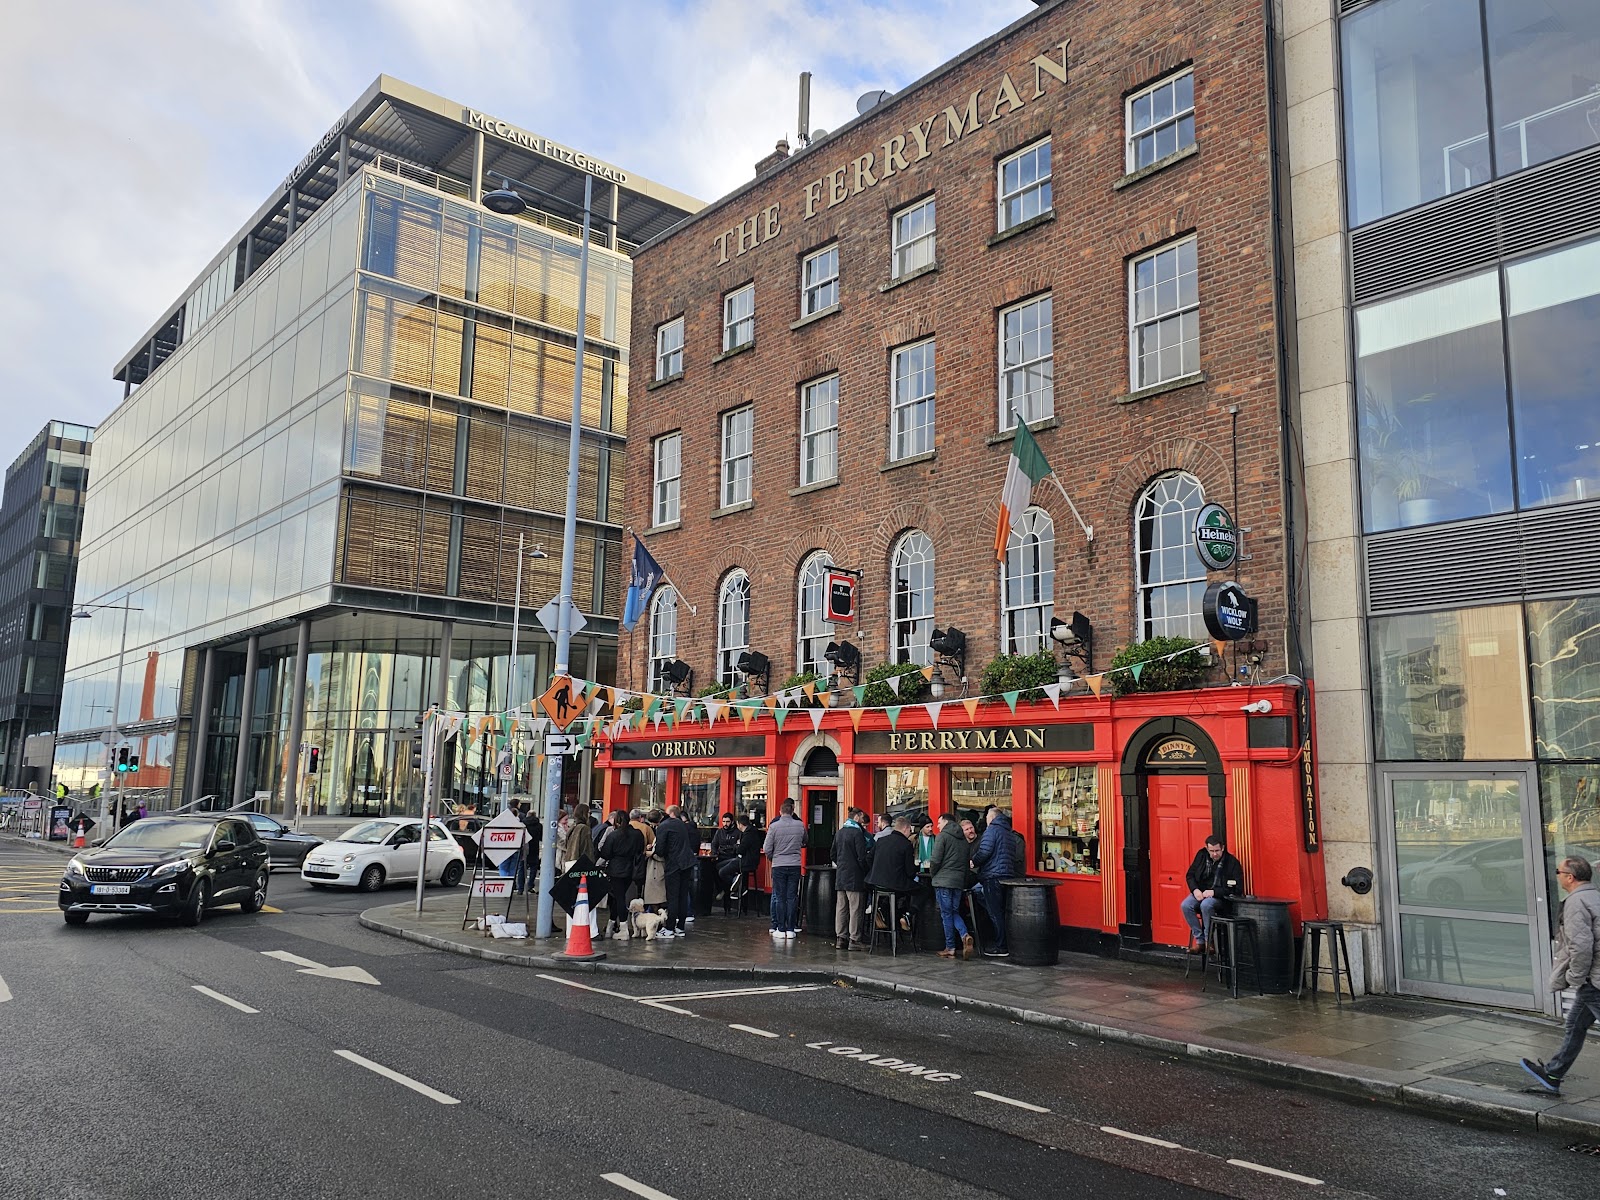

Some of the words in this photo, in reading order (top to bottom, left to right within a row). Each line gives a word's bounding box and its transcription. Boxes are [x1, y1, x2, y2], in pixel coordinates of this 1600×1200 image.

[713, 202, 782, 268] THE
[802, 38, 1072, 222] FERRYMAN
[1221, 605, 1247, 619] WICKLOW
[1226, 615, 1243, 627] WOLF
[651, 740, 716, 758] O'BRIENS
[888, 728, 1047, 751] FERRYMAN
[1161, 741, 1192, 753] DINNY'S
[1301, 694, 1317, 845] ACMMODATION
[805, 1041, 962, 1082] LOADING
